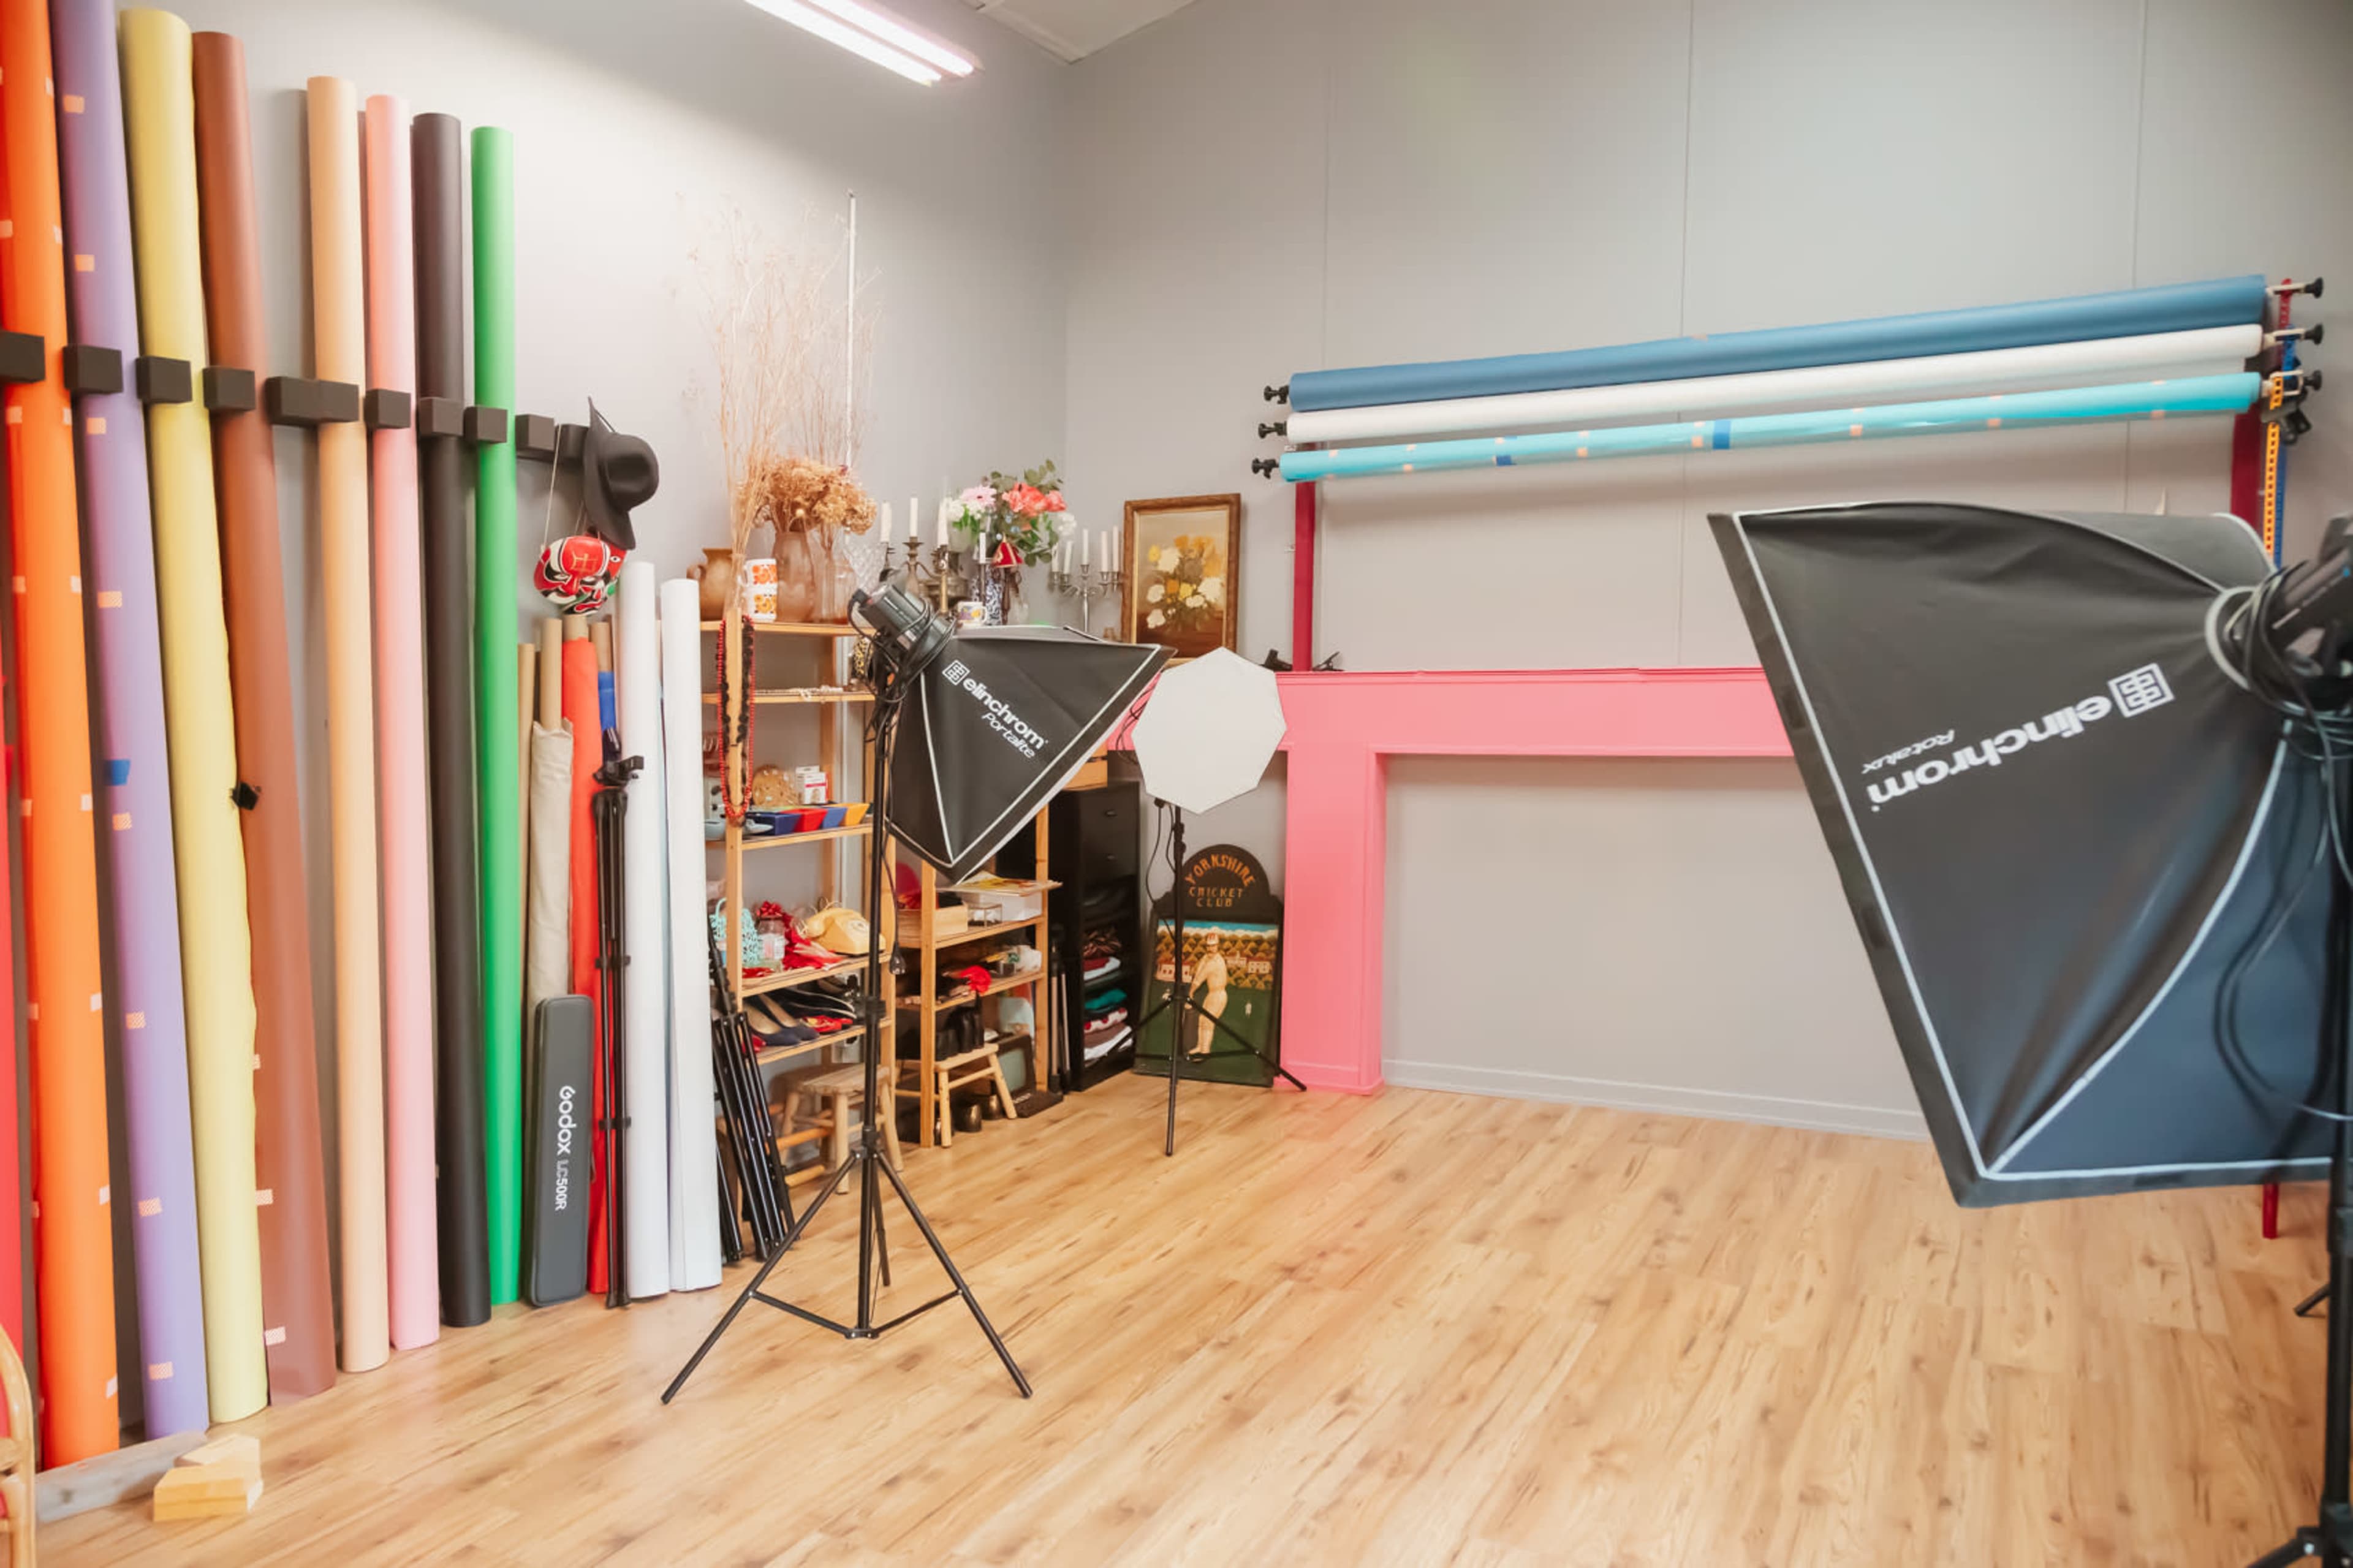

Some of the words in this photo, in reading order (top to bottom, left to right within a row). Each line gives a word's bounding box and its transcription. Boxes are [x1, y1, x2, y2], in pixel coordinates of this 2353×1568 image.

[963, 678, 1045, 749] elinchrom
[981, 712, 1035, 758] Portalite
[1862, 730, 1955, 773] Rotalux
[1866, 696, 2112, 803] elinchrom
[1184, 854, 1256, 887] YORKSHIRE
[1189, 886, 1243, 898] CRICKET
[1196, 897, 1233, 907] CLUB
[557, 1085, 577, 1156] Godox
[555, 1159, 569, 1211] LC500R
